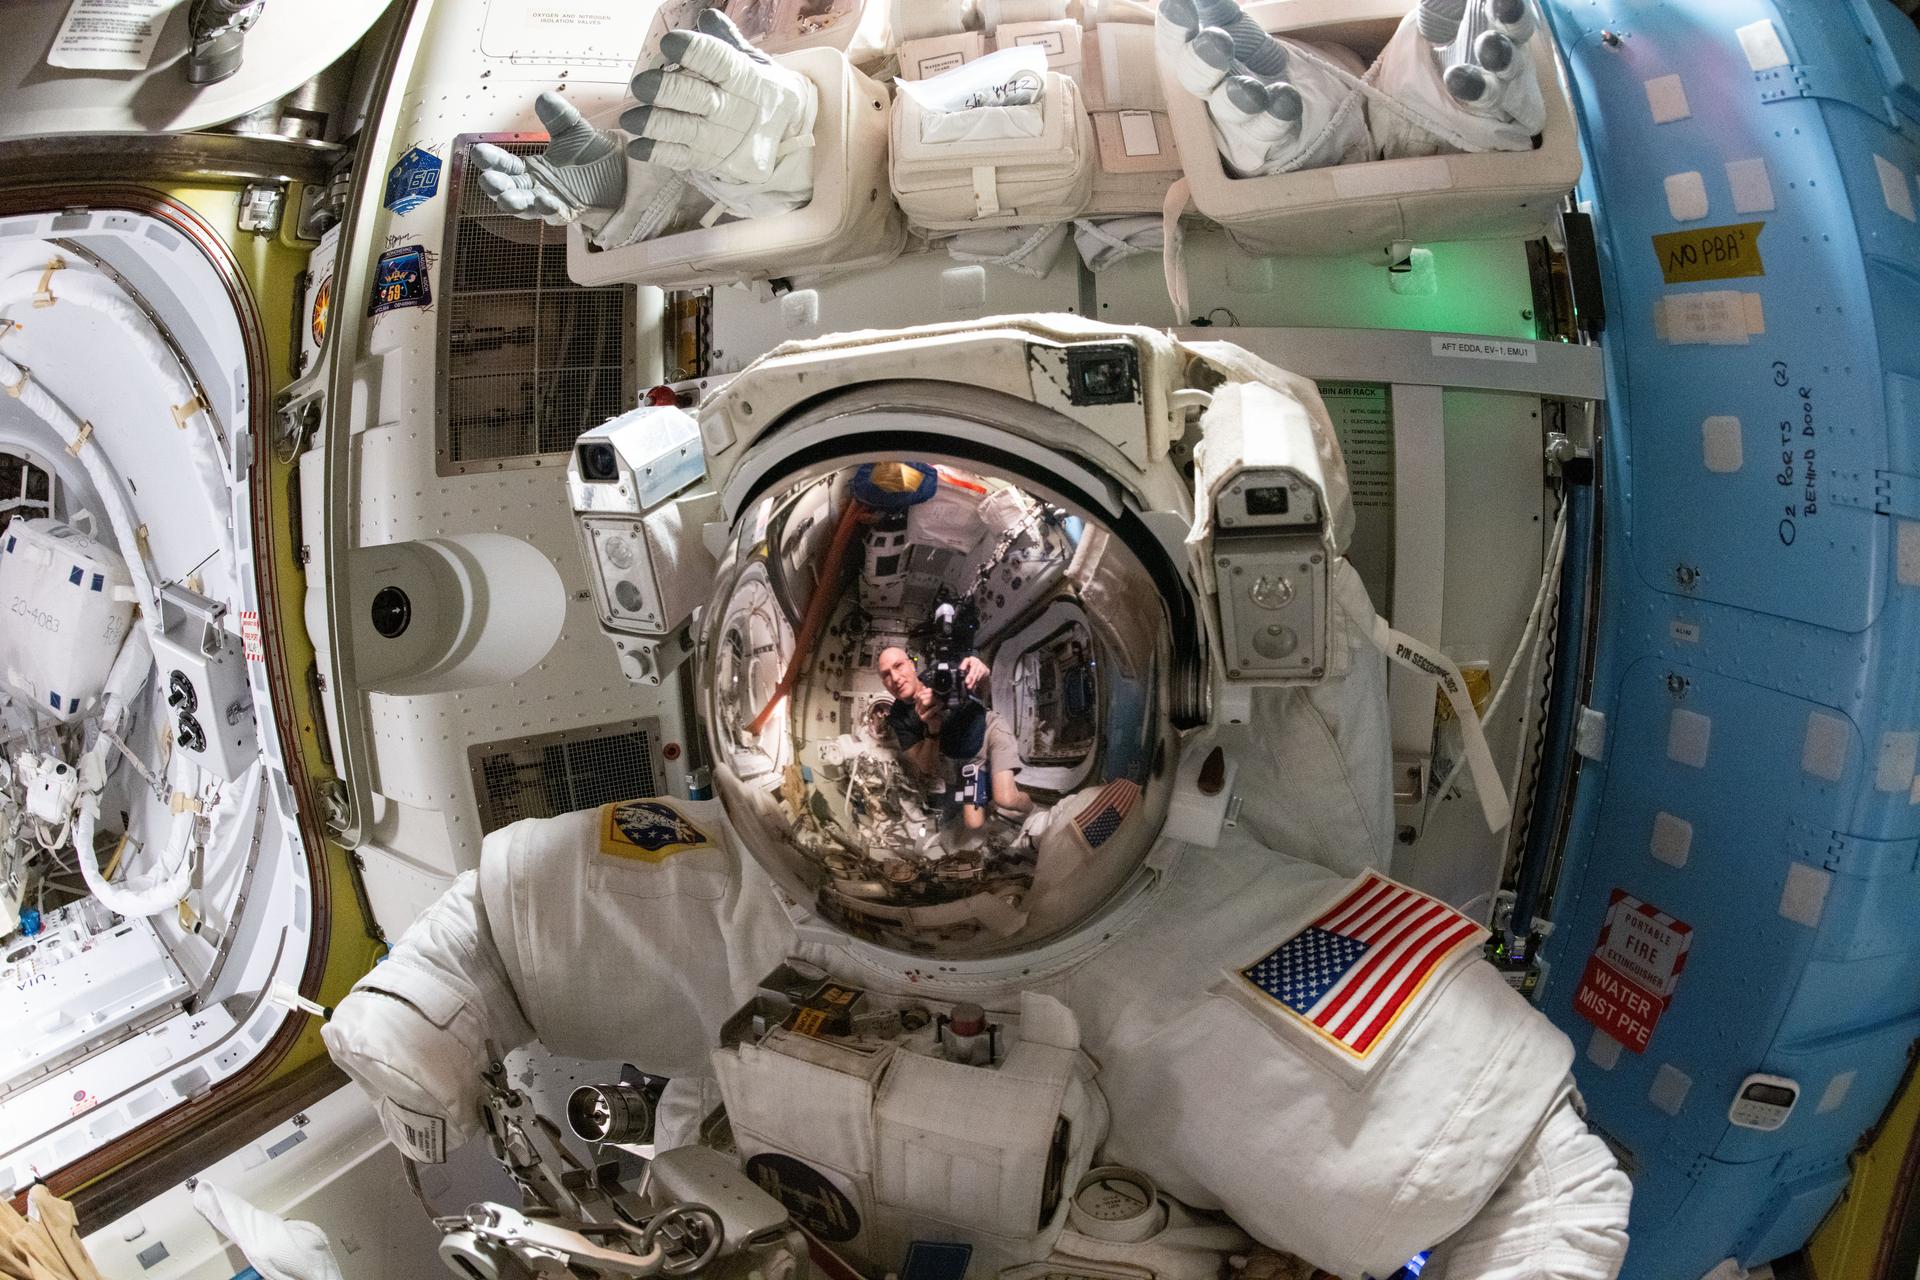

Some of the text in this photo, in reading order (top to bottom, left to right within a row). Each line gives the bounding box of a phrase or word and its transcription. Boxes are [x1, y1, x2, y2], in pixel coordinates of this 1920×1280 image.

[407, 169, 440, 191] 60
[1668, 243, 1698, 273] NO
[387, 284, 401, 304] 59
[1441, 343, 1457, 351] AFT
[1458, 343, 1482, 354] EDDA,
[1507, 347, 1528, 357] EMU1
[1771, 361, 1789, 387] (2)
[1319, 387, 1376, 397] ABIN AIR RACK
[1776, 420, 1794, 487] PORTS
[1798, 386, 1818, 518] BEHIND DOOR
[11, 596, 61, 633] 20-4083
[1395, 643, 1413, 661] P/N
[1625, 913, 1672, 946] PORTABLE
[1625, 935, 1659, 965] FIRE
[1607, 950, 1664, 990] EXTINGUISHER
[1595, 968, 1651, 1020] WATER
[1579, 985, 1650, 1045] MIST PFE
